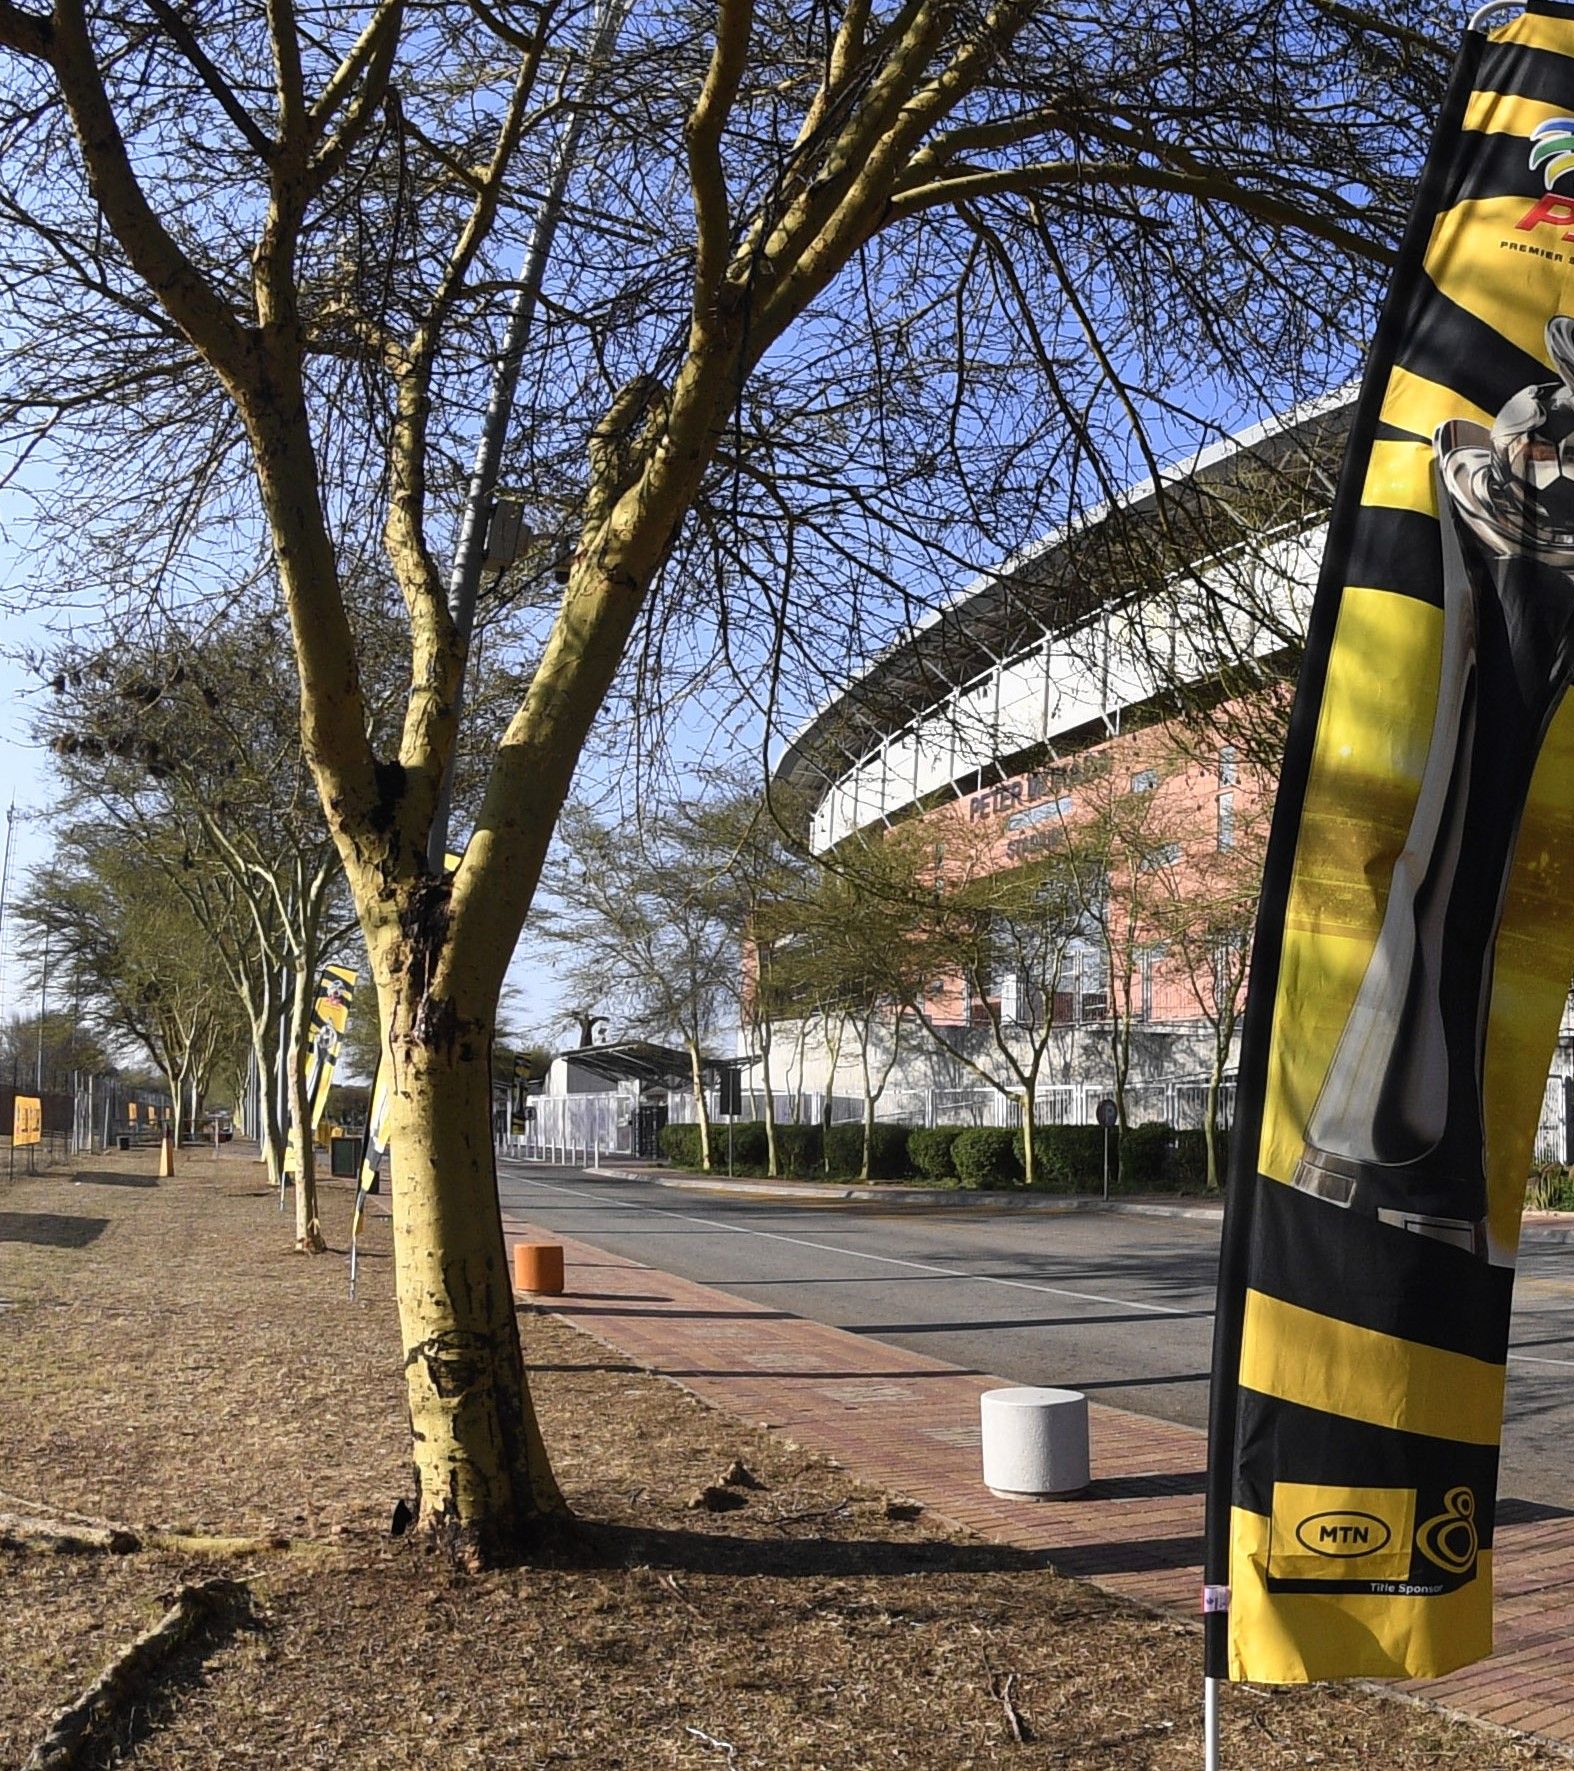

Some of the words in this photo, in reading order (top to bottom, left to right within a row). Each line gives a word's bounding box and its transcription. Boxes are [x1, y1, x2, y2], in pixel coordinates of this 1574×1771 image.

[1500, 241, 1563, 262] PREMIER
[1319, 1525, 1369, 1543] MTN
[1370, 1582, 1395, 1593] Title
[1398, 1583, 1443, 1595] Sponsor
